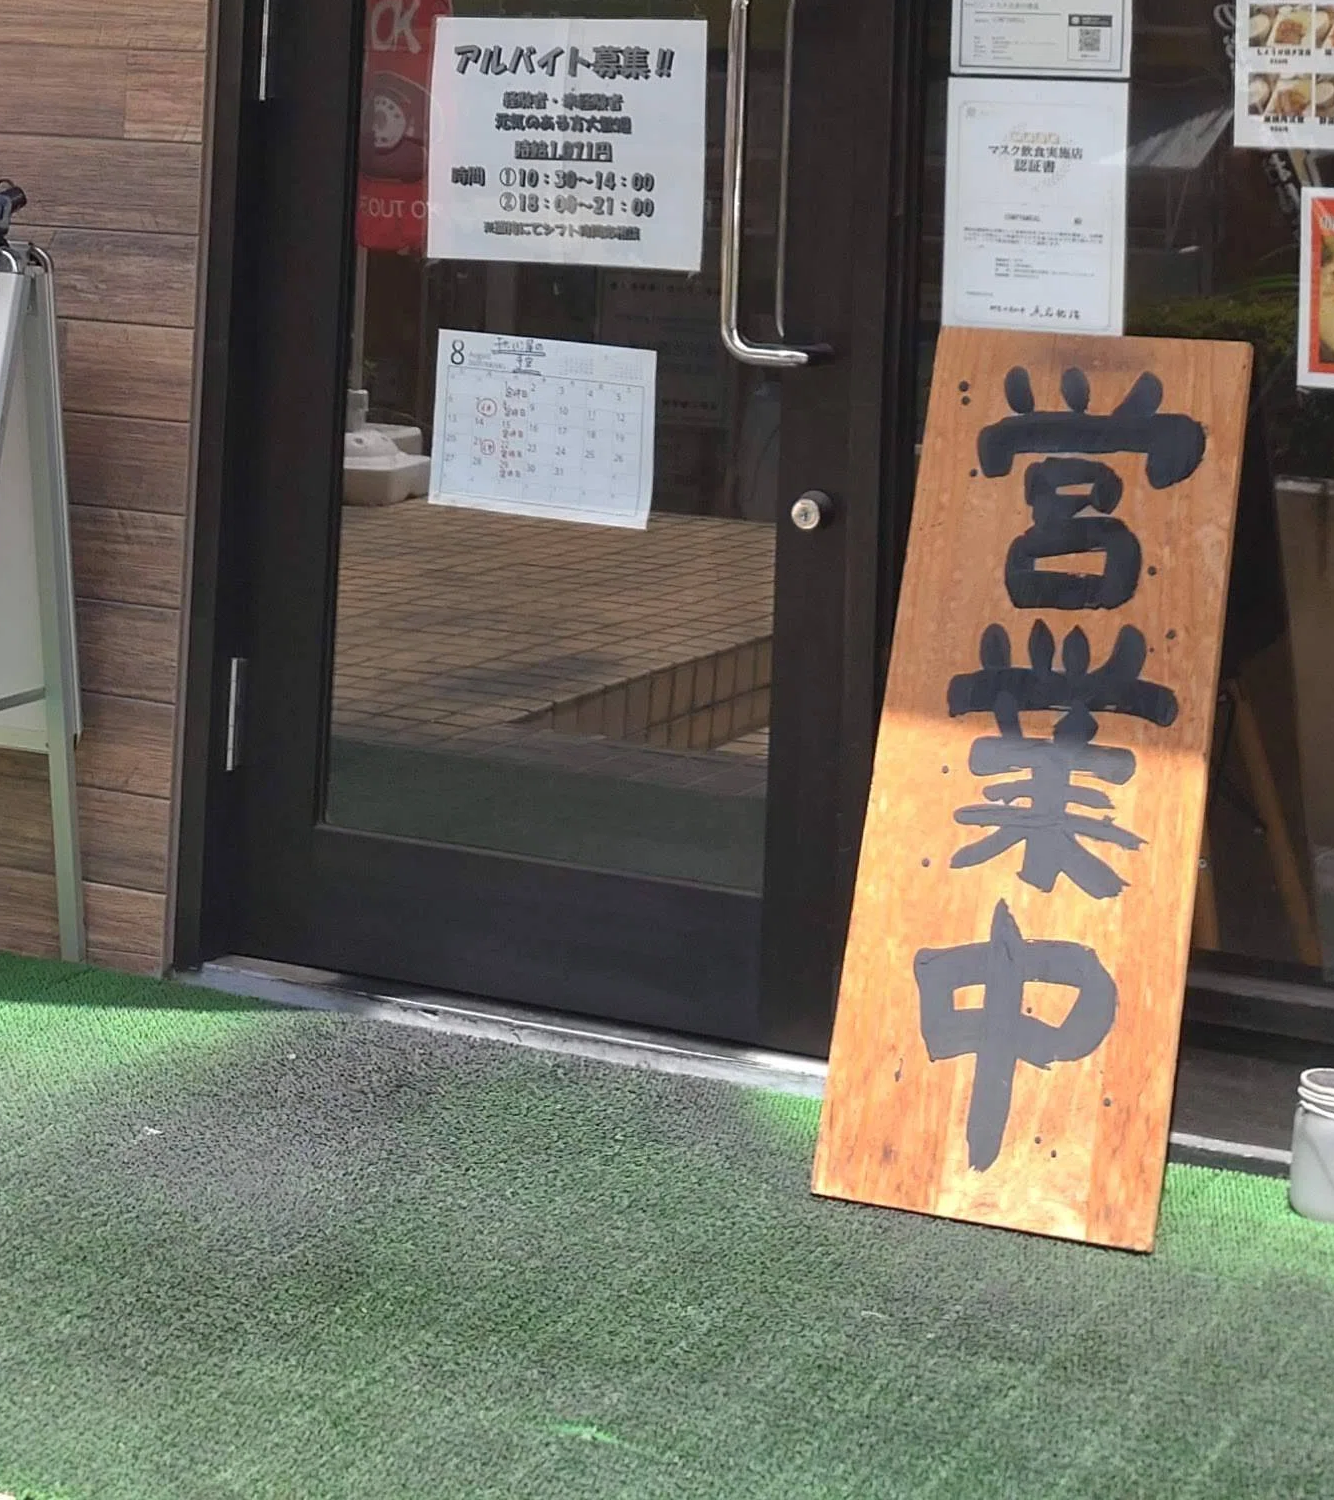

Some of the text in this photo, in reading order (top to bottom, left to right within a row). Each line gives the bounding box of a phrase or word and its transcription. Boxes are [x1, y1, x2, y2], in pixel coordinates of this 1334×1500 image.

[988, 144, 1083, 160] マスク飲食実施店
[451, 166, 486, 187] 時間
[1014, 159, 1056, 174] 認証書
[451, 339, 465, 366] 8
[913, 365, 1207, 1173] 営業中
